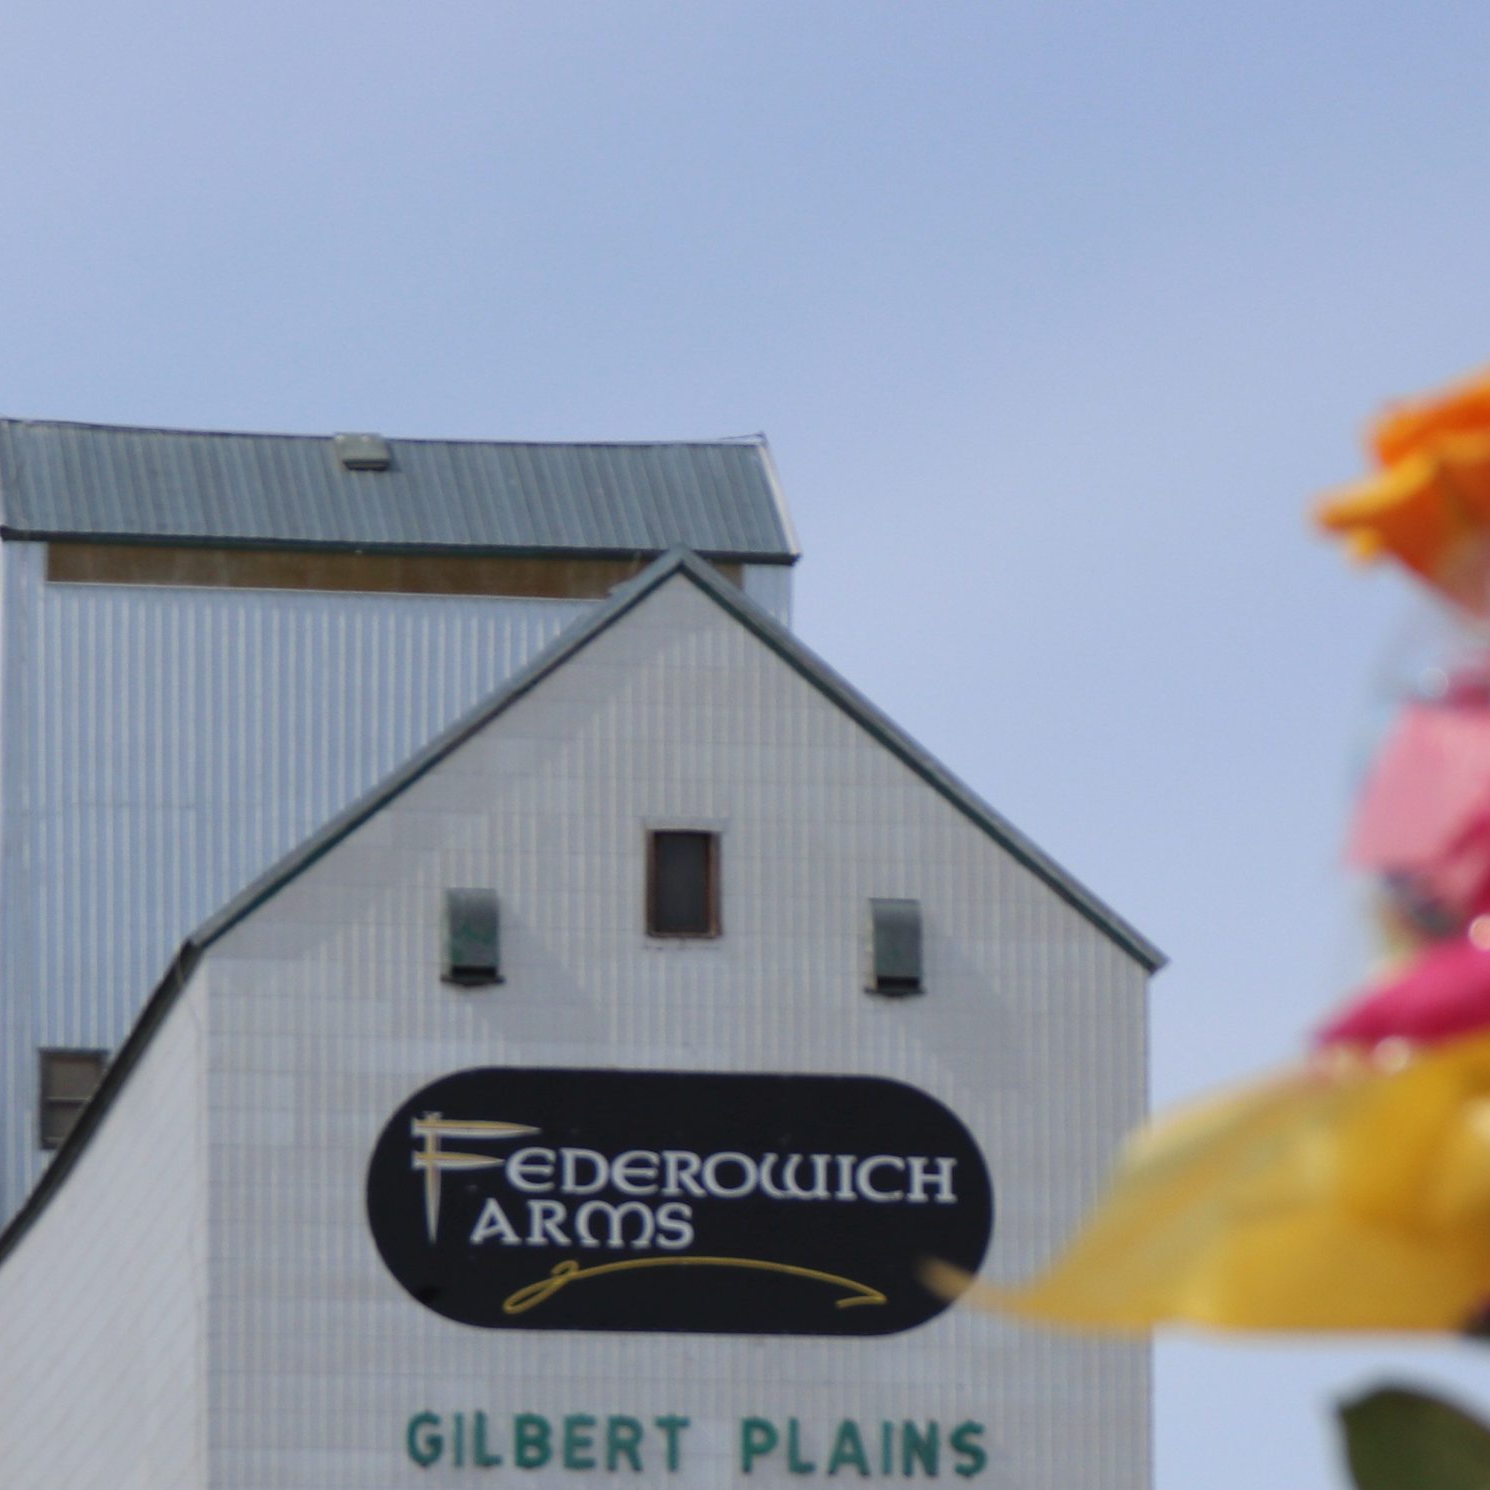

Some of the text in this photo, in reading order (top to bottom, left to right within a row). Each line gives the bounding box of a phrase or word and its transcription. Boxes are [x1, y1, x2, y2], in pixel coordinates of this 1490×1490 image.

[411, 1111, 957, 1243] FEDEROWICH
[470, 1199, 695, 1249] ARMS
[407, 1411, 988, 1478] GILBERT PLAINS
